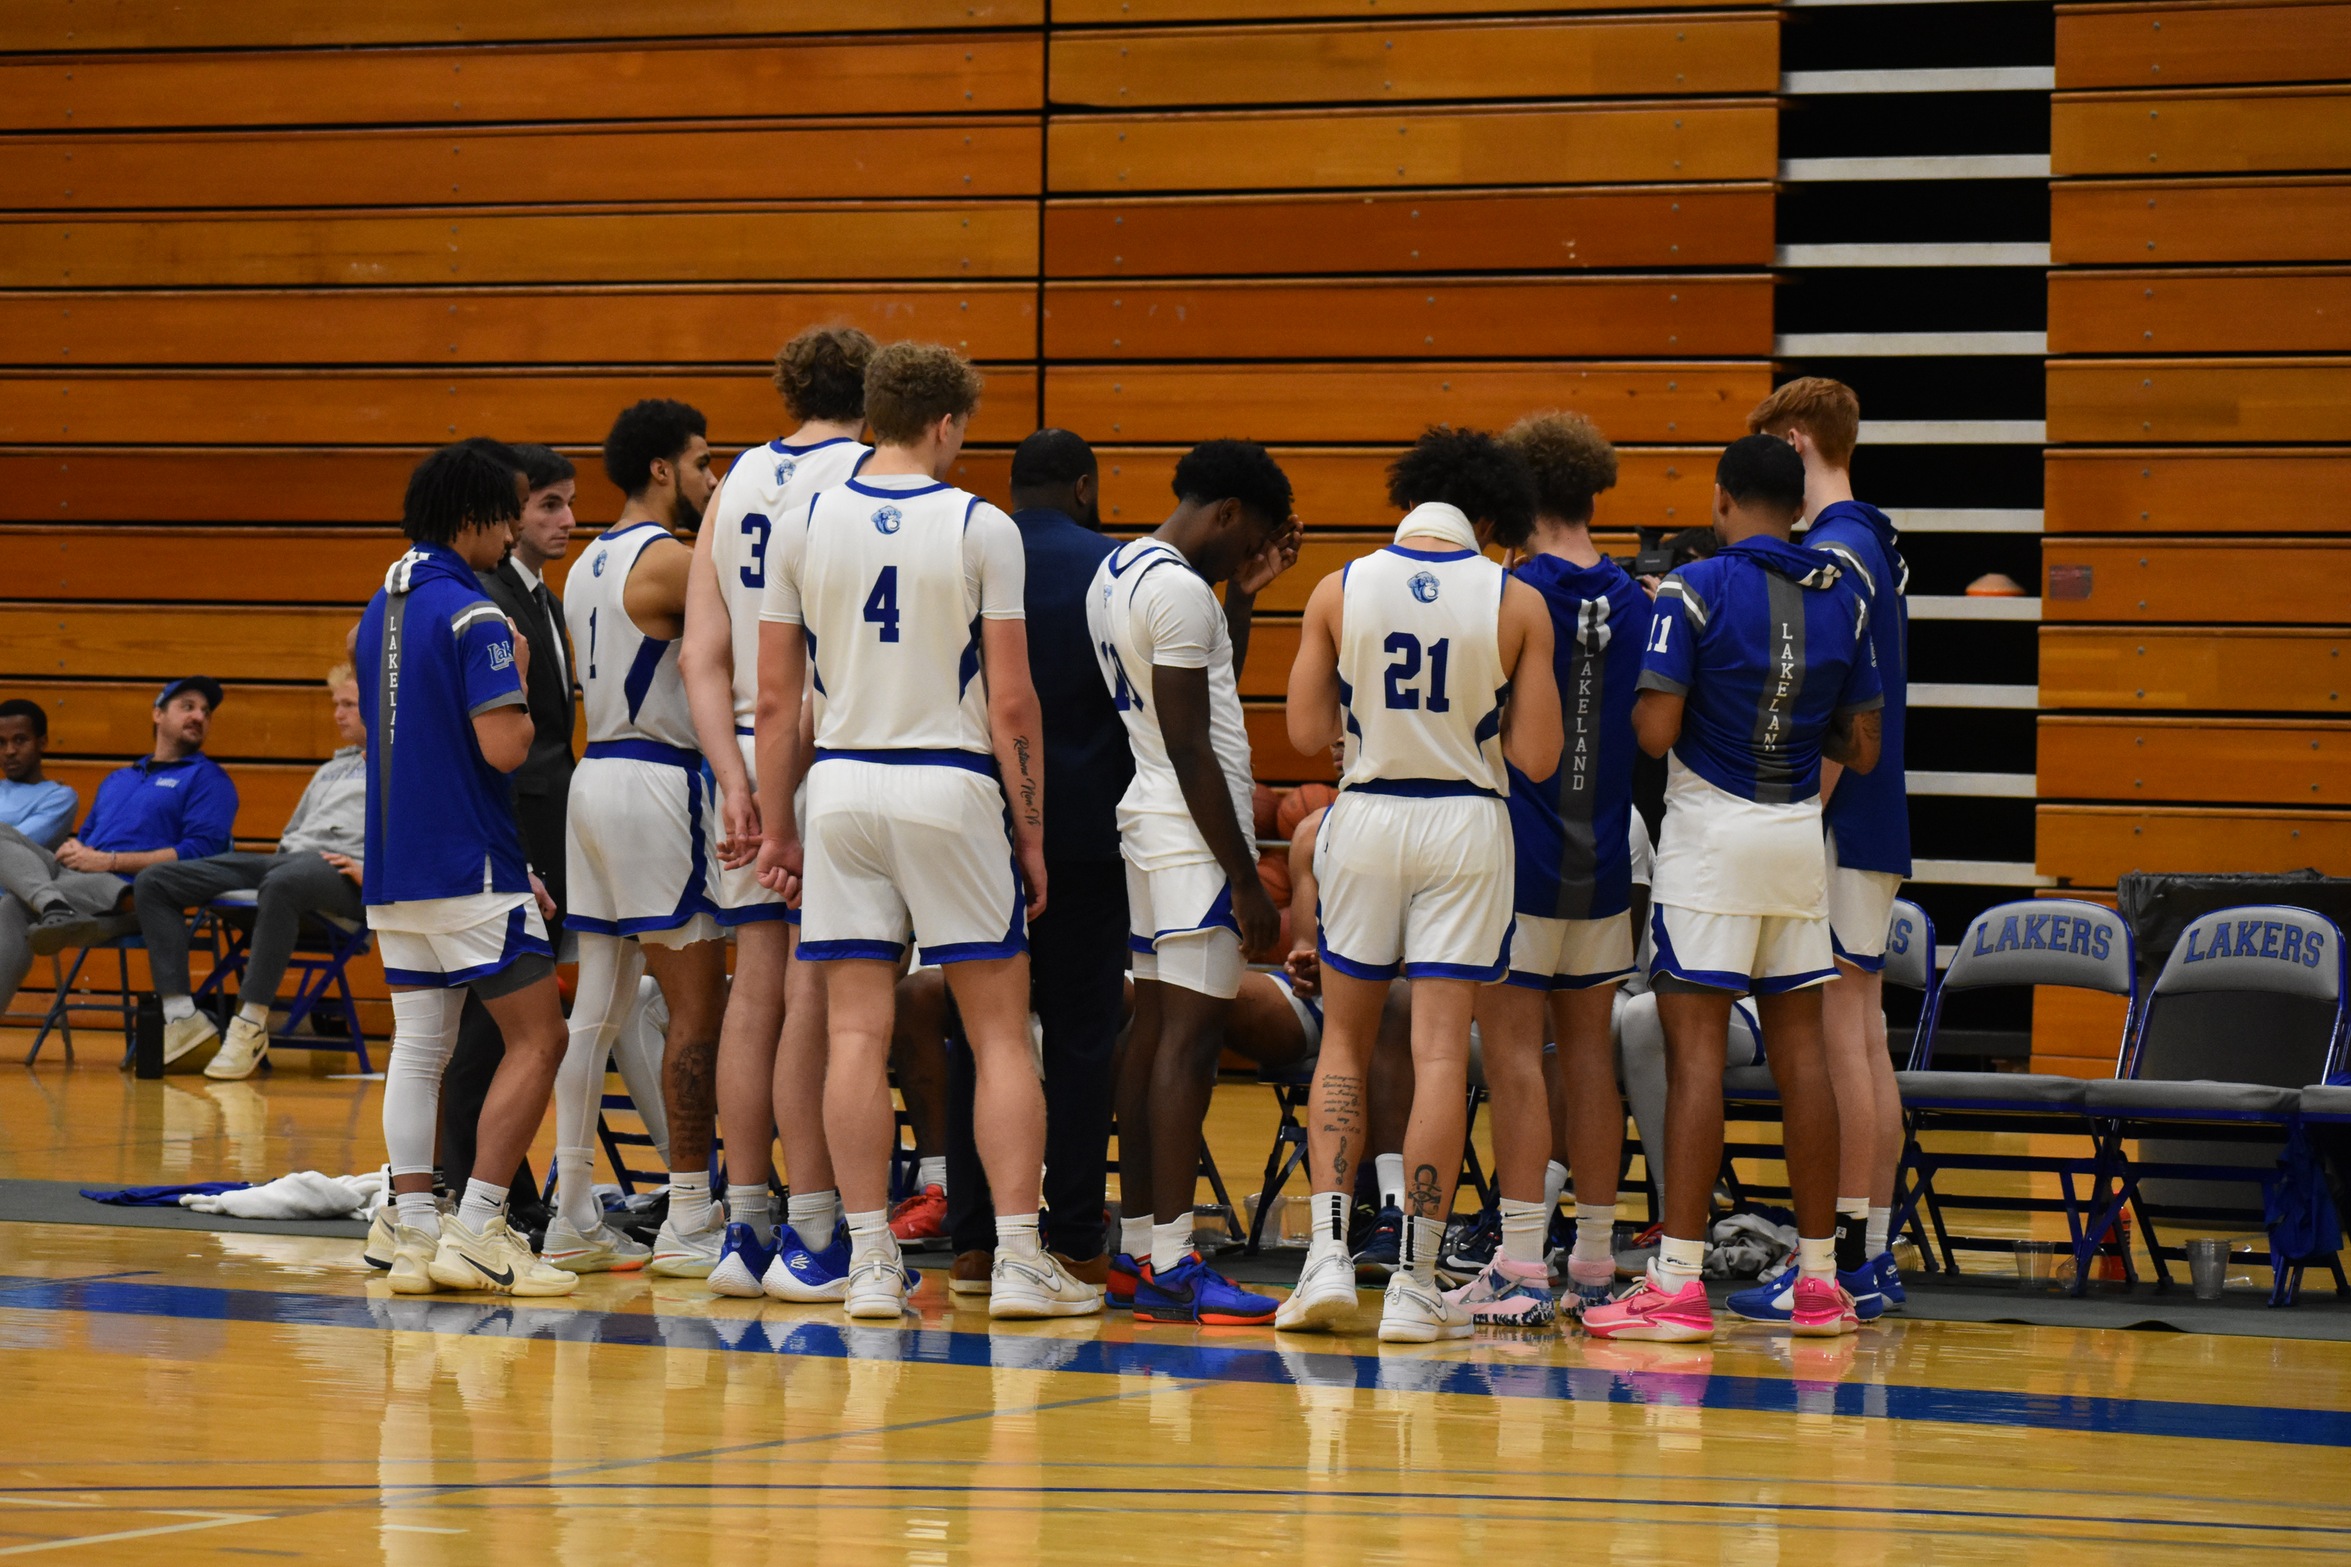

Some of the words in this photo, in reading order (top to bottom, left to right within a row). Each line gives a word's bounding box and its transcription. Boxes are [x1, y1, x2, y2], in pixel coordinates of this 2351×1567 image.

[740, 513, 772, 589] 3
[863, 566, 900, 643] 4
[588, 607, 597, 680] 1
[1383, 631, 1450, 713] 21
[1572, 645, 1595, 791] LAKELAND
[1973, 913, 2113, 961] LAKERS
[2183, 920, 2325, 969] LAKERS
